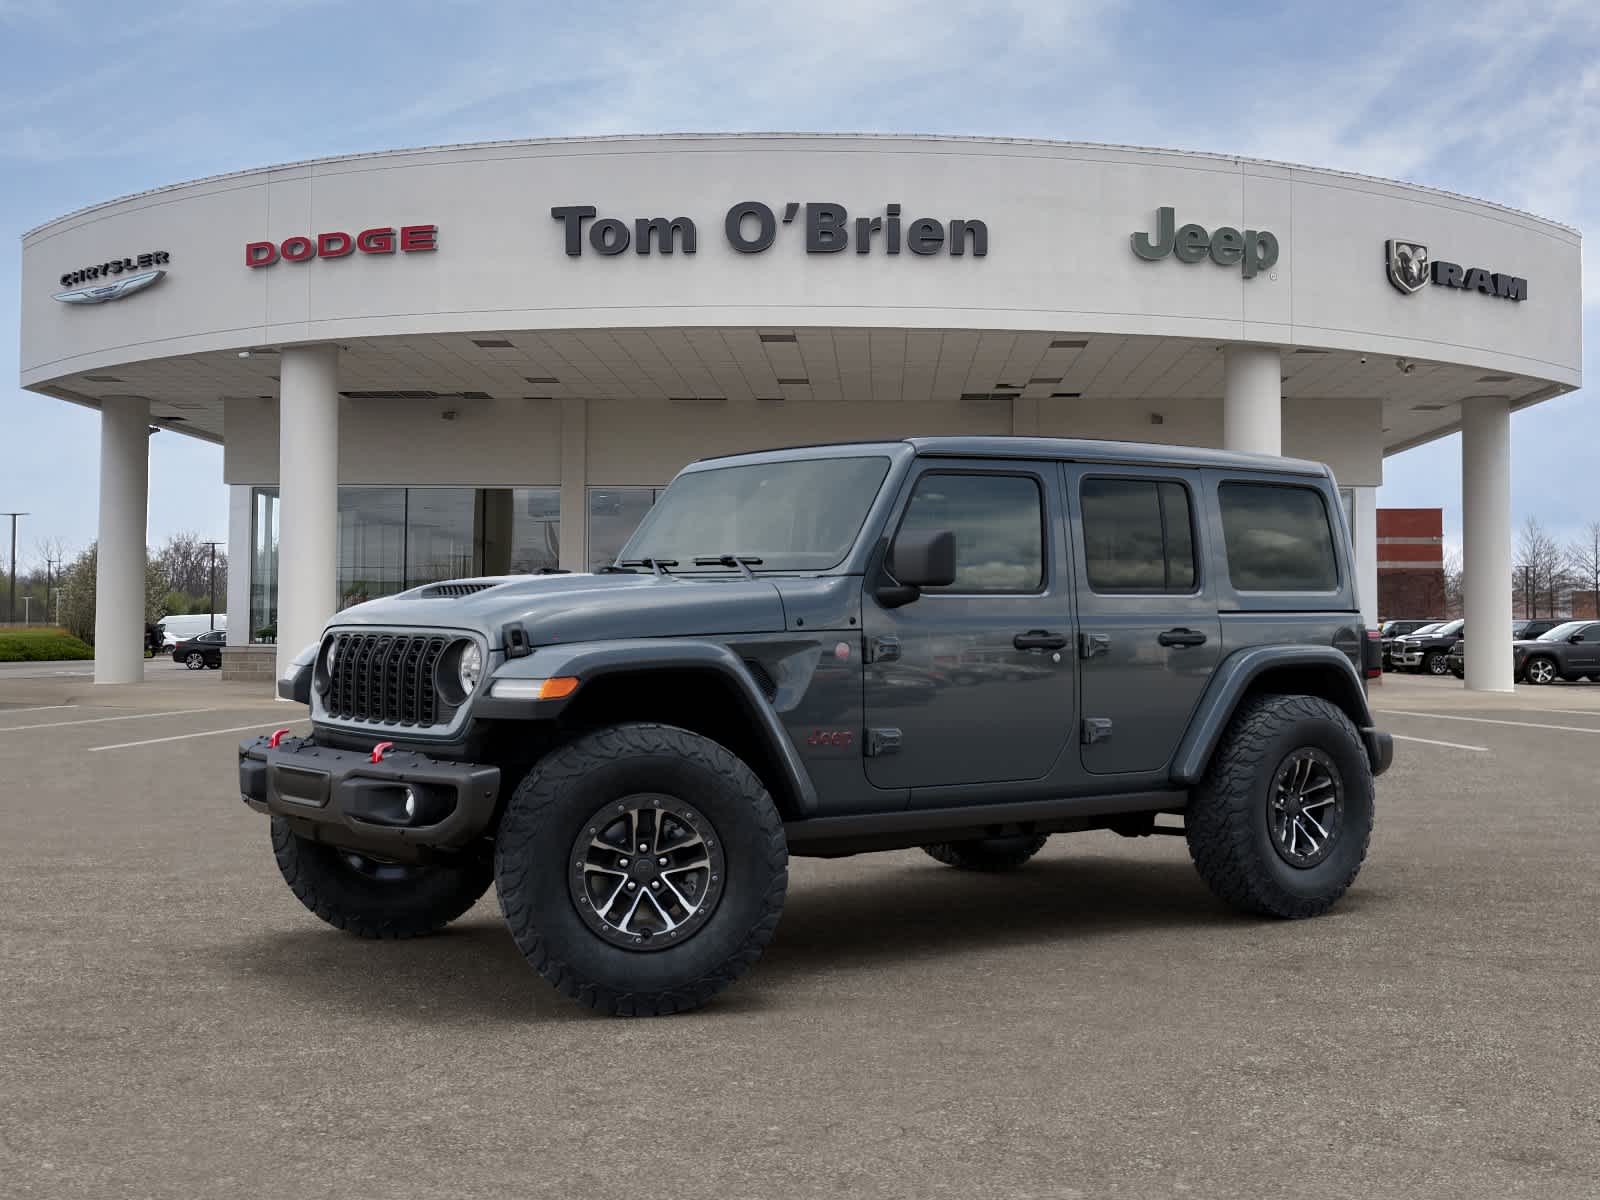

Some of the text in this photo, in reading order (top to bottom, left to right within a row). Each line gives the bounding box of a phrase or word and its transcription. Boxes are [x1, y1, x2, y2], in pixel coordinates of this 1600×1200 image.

[245, 224, 438, 269] DODGE
[551, 206, 697, 256] Tom
[1130, 207, 1279, 279] Jeep
[60, 249, 170, 287] CHRYSLER
[1431, 261, 1528, 301] RAM
